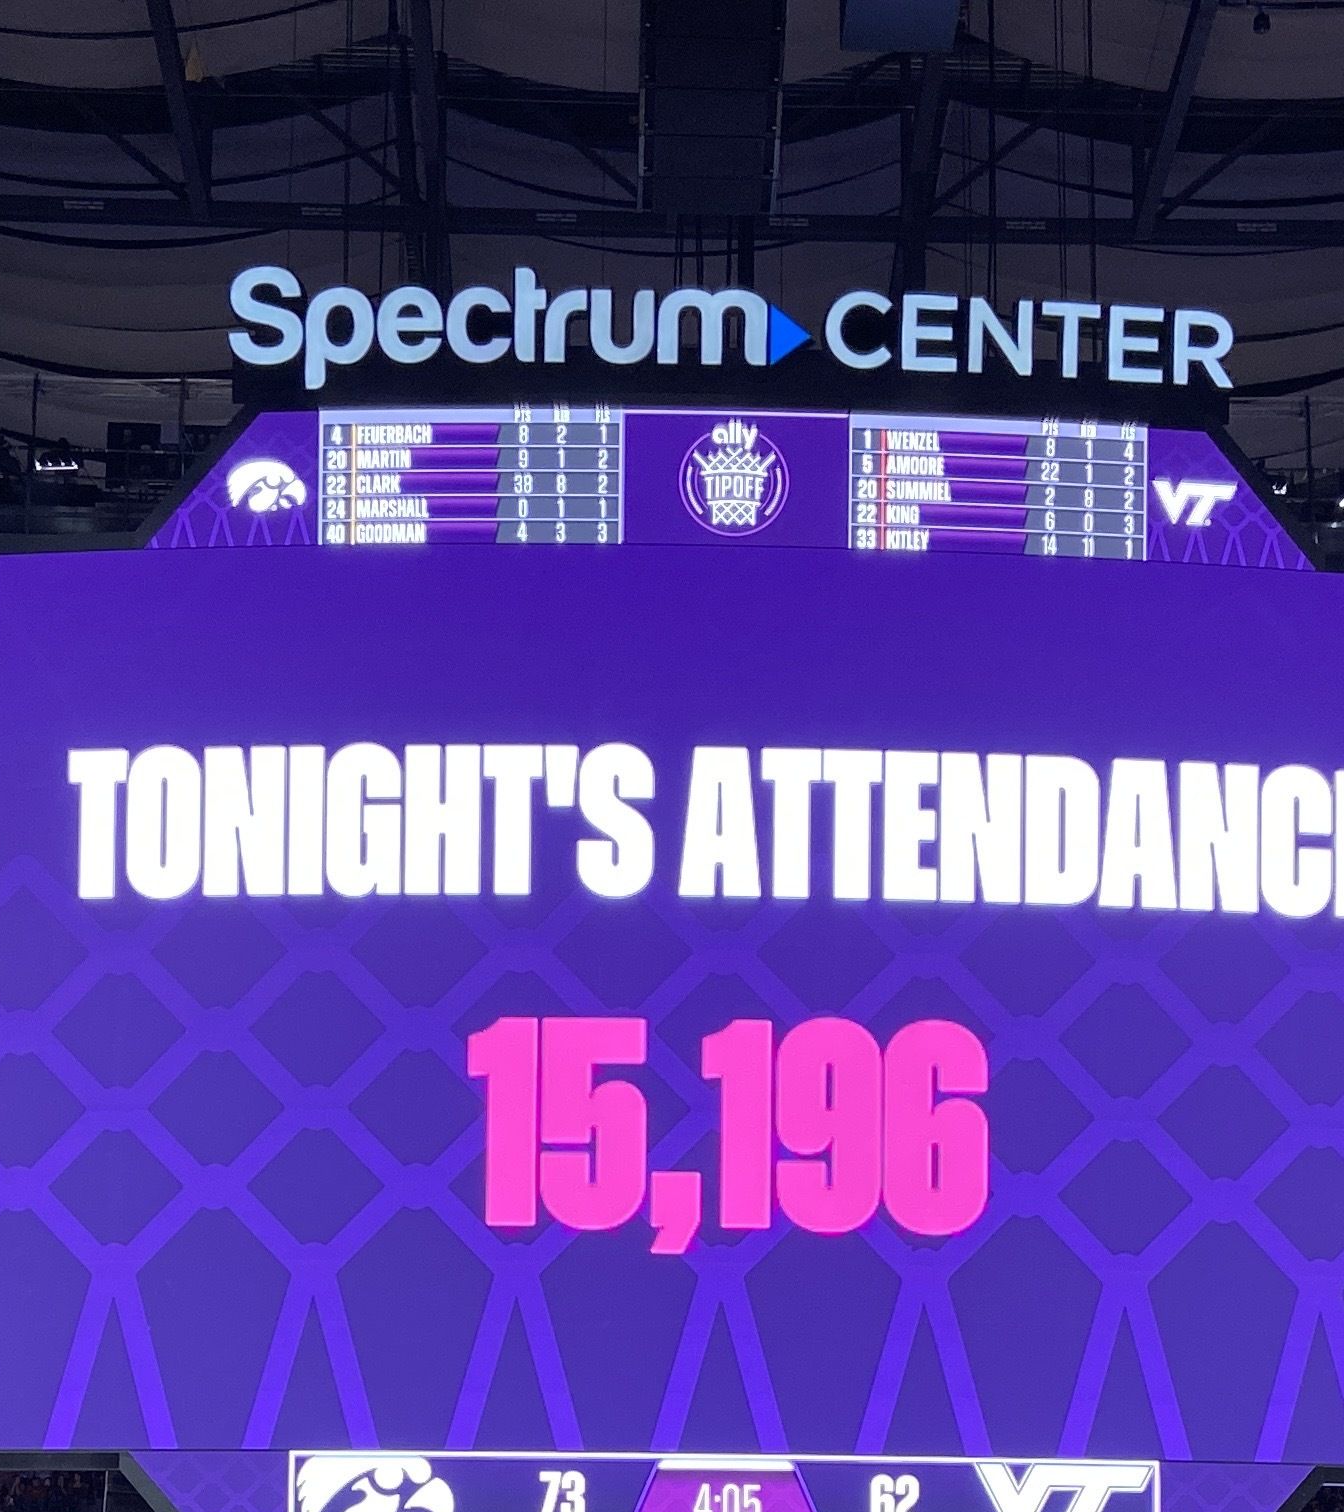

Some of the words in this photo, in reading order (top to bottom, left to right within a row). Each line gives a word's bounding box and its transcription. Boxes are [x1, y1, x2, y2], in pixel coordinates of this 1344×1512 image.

[229, 266, 769, 389] Spectrum
[826, 290, 1234, 389] CENTER
[514, 409, 531, 423] PTS
[1042, 422, 1059, 436] PTS
[330, 424, 343, 444] 4
[357, 424, 432, 444] FEUERBACH
[518, 425, 529, 444] 8
[557, 425, 567, 444] 2
[599, 425, 607, 444] 1
[712, 421, 758, 449] ally
[863, 430, 872, 449] 1
[887, 431, 940, 451] WENZEL
[1045, 438, 1056, 457] 8
[1085, 440, 1093, 459] 1
[1123, 442, 1134, 461] 4
[327, 450, 347, 469] 20
[357, 450, 411, 469] MARTIN
[518, 450, 528, 469] 9
[558, 450, 565, 469] 1
[598, 450, 608, 469] 2
[862, 455, 873, 474] 5
[887, 455, 945, 476] AMOORE
[1041, 463, 1059, 482] 22
[1086, 464, 1093, 483] 1
[1124, 467, 1134, 486] 2
[327, 474, 347, 494] 22
[357, 474, 402, 494] CLARK
[513, 474, 533, 494] 38
[556, 474, 567, 494] 8
[597, 474, 608, 494] 2
[705, 475, 765, 500] TIPOFF
[857, 480, 878, 499] 20
[887, 481, 952, 502] SUMMIEL
[1045, 488, 1055, 507] 2
[1084, 489, 1094, 508] 8
[1124, 492, 1134, 511] 2
[327, 499, 346, 519] 24
[357, 499, 429, 518] MARSHALL
[518, 499, 529, 518] 0
[558, 499, 565, 518] 1
[599, 499, 607, 518] 1
[1152, 479, 1238, 527] VT
[327, 523, 346, 543] 40
[357, 523, 426, 543] GOODMAN
[516, 523, 528, 543] 4
[556, 523, 567, 543] 3
[597, 523, 608, 543] 3
[857, 504, 877, 523] 22
[887, 505, 920, 526] KING
[1045, 513, 1055, 532] 6
[1084, 514, 1094, 533] 0
[1124, 515, 1134, 535] 3
[857, 529, 877, 549] 33
[887, 529, 930, 551] KITLEY
[1041, 536, 1057, 556] 14
[1083, 538, 1096, 557] 11
[1125, 541, 1133, 560] 1
[67, 742, 656, 901] TONIGHT'S
[466, 1016, 990, 1257] 15,196
